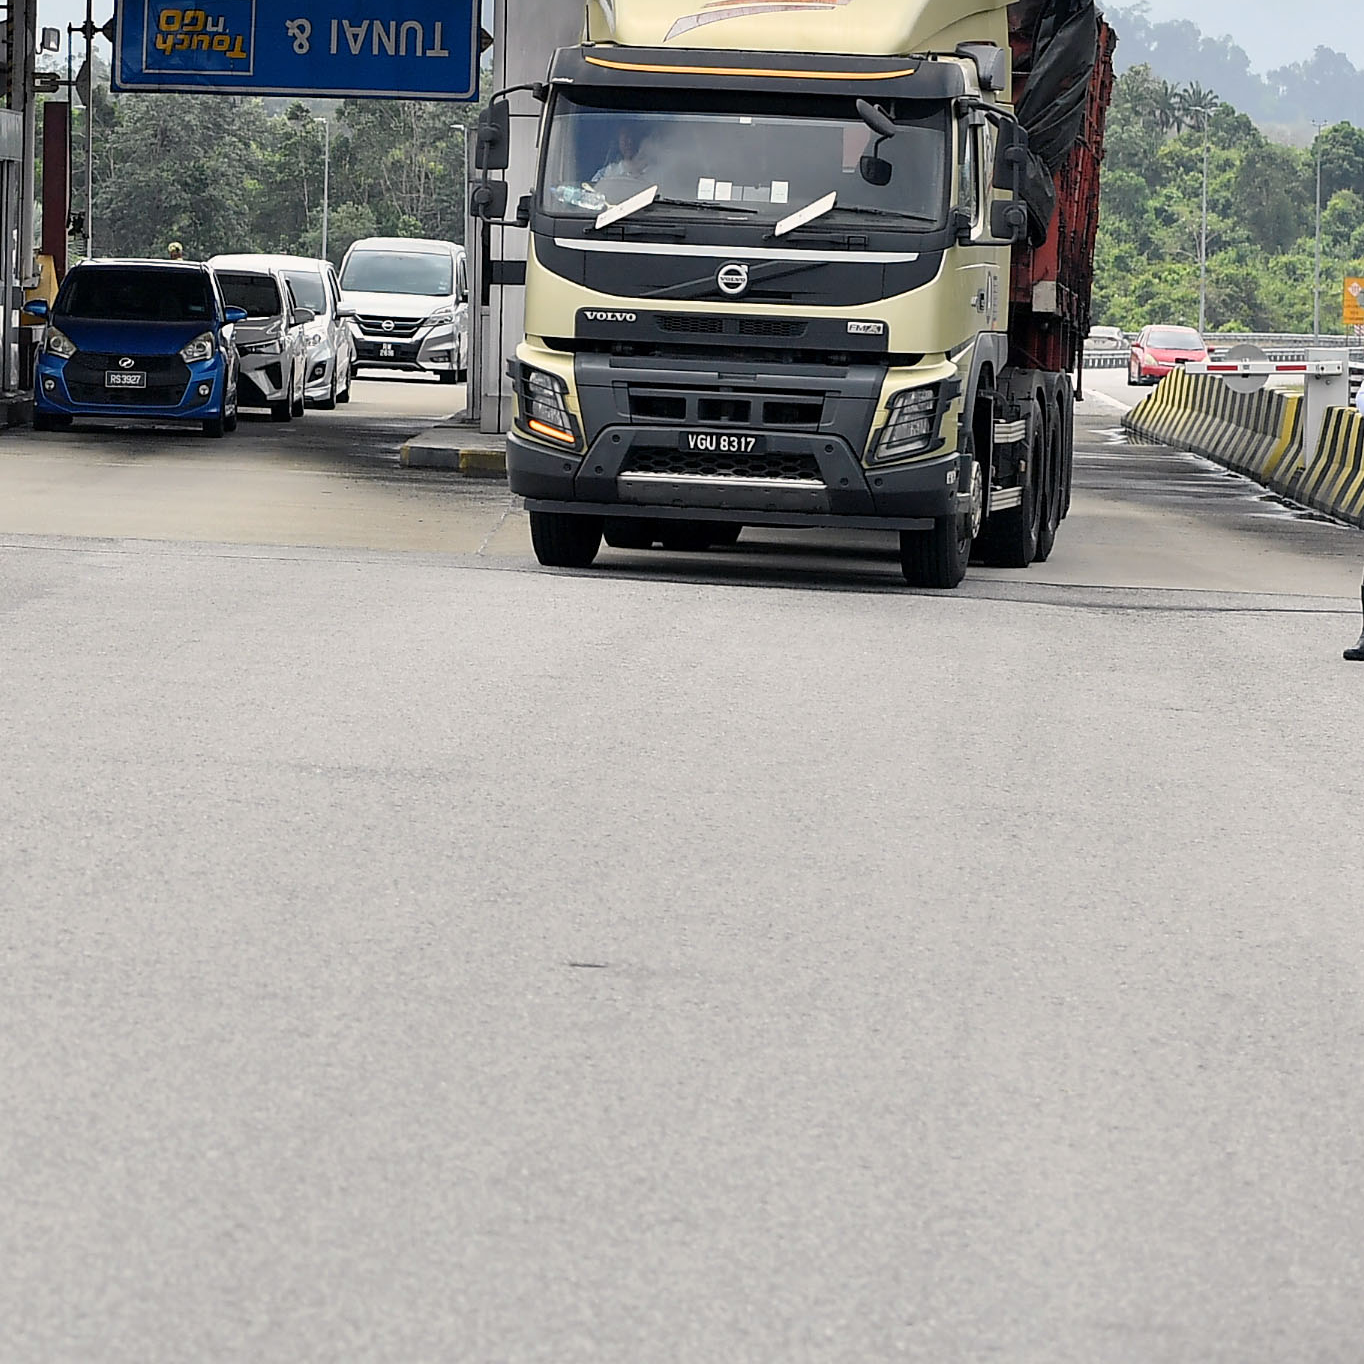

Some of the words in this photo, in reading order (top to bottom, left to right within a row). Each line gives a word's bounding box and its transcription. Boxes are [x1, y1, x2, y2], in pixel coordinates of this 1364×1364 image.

[156, 33, 247, 59] Touch
[285, 18, 312, 54] &
[330, 19, 449, 57] TUNAI
[584, 311, 637, 322] VOLVO
[688, 434, 716, 451] VGU
[719, 435, 756, 452] 8317
